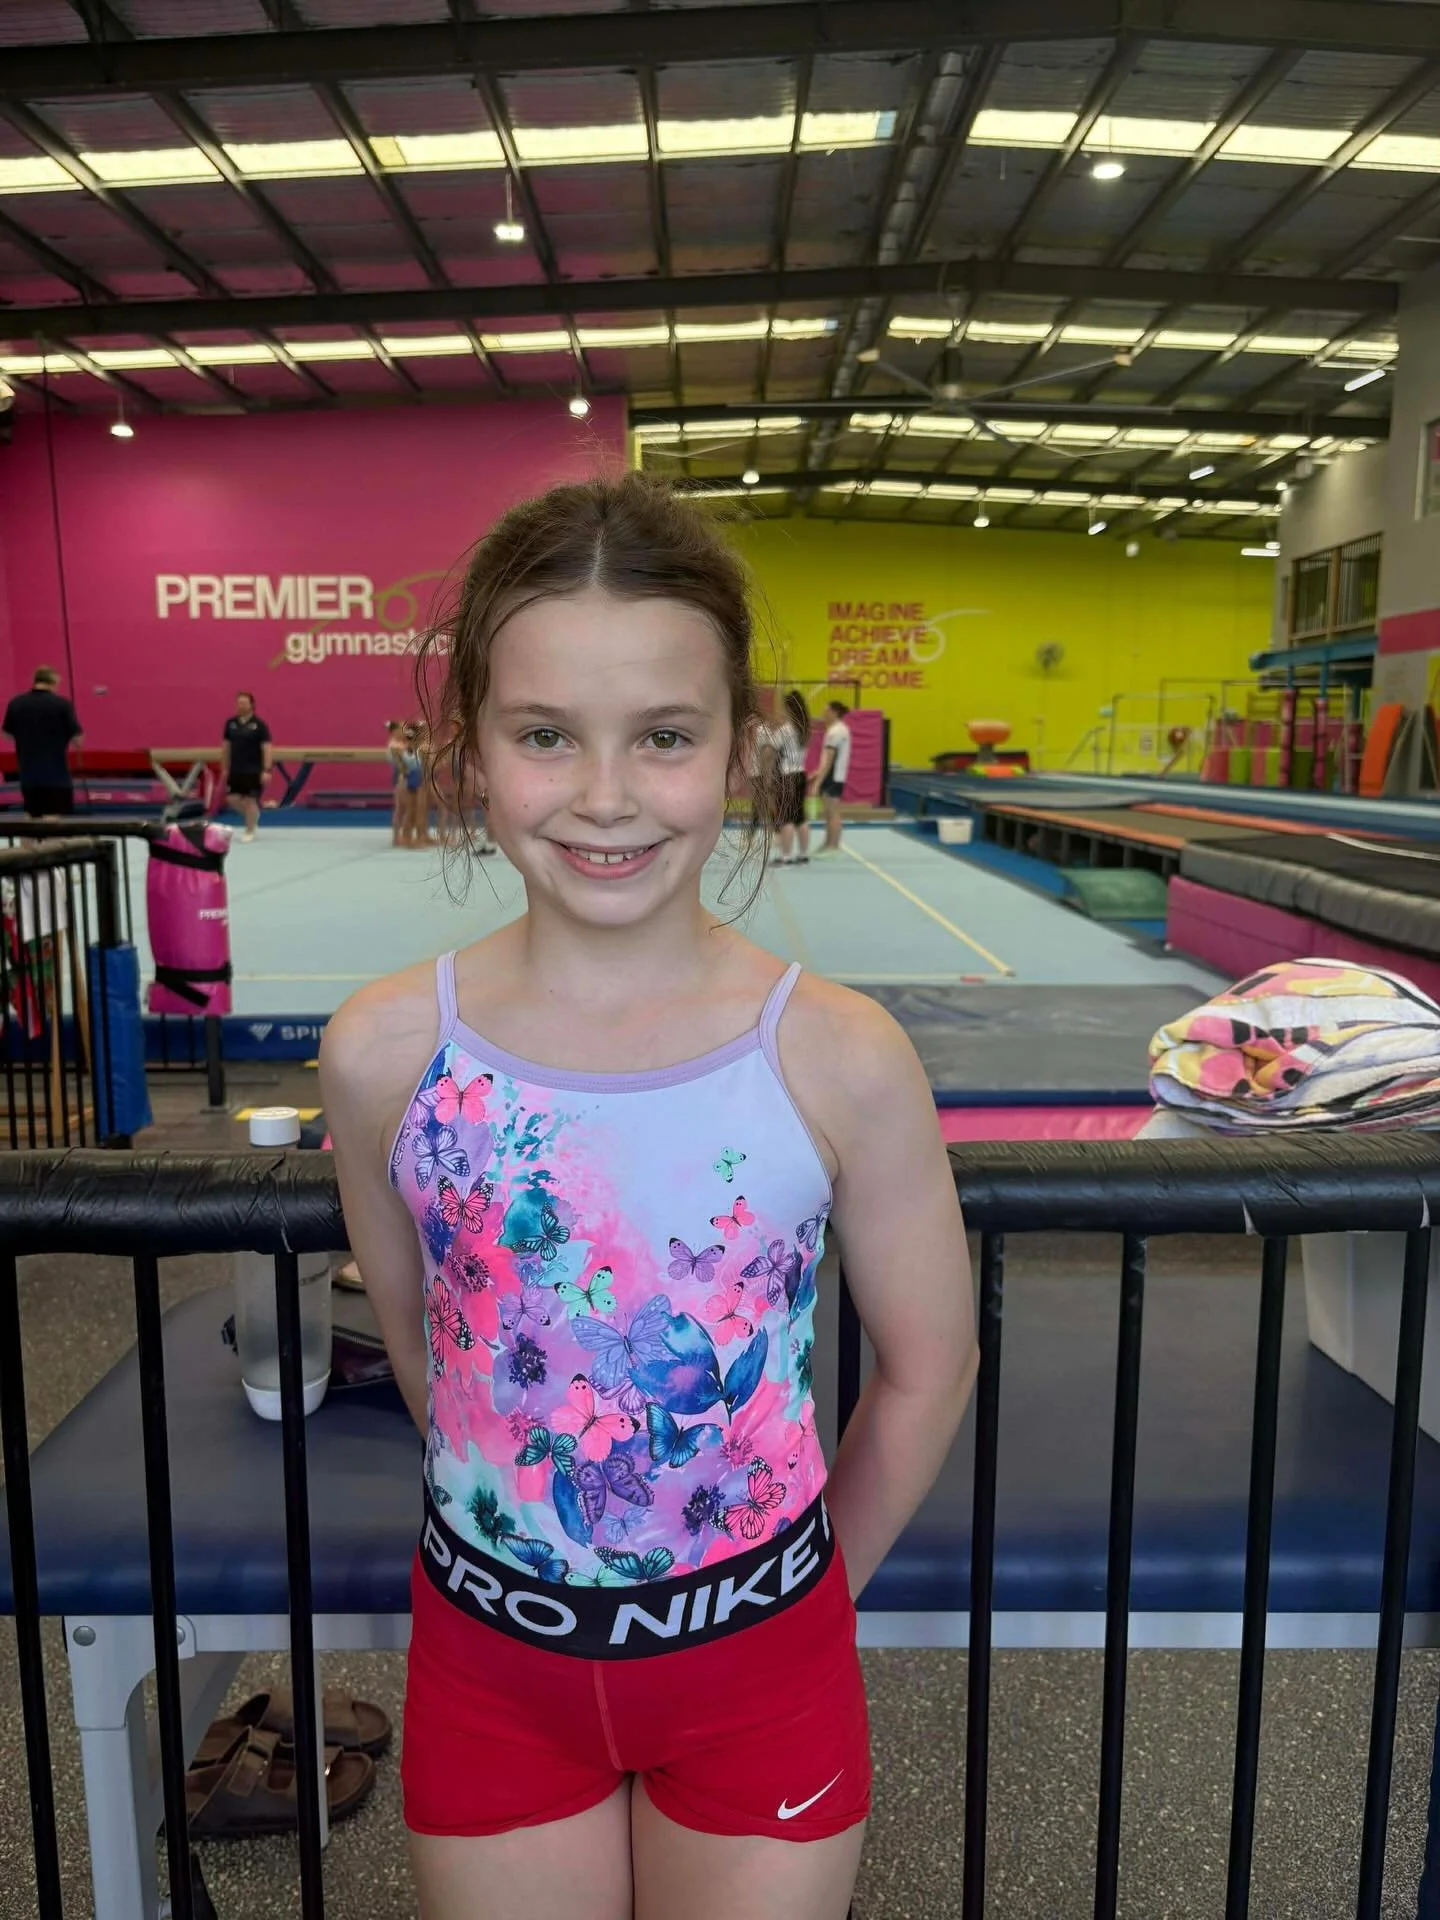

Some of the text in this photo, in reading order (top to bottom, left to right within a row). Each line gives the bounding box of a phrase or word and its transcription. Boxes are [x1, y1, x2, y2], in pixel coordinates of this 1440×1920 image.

[155, 574, 374, 620] PREMIER
[424, 1514, 577, 1636] PRO
[609, 1516, 820, 1645] NIKE
